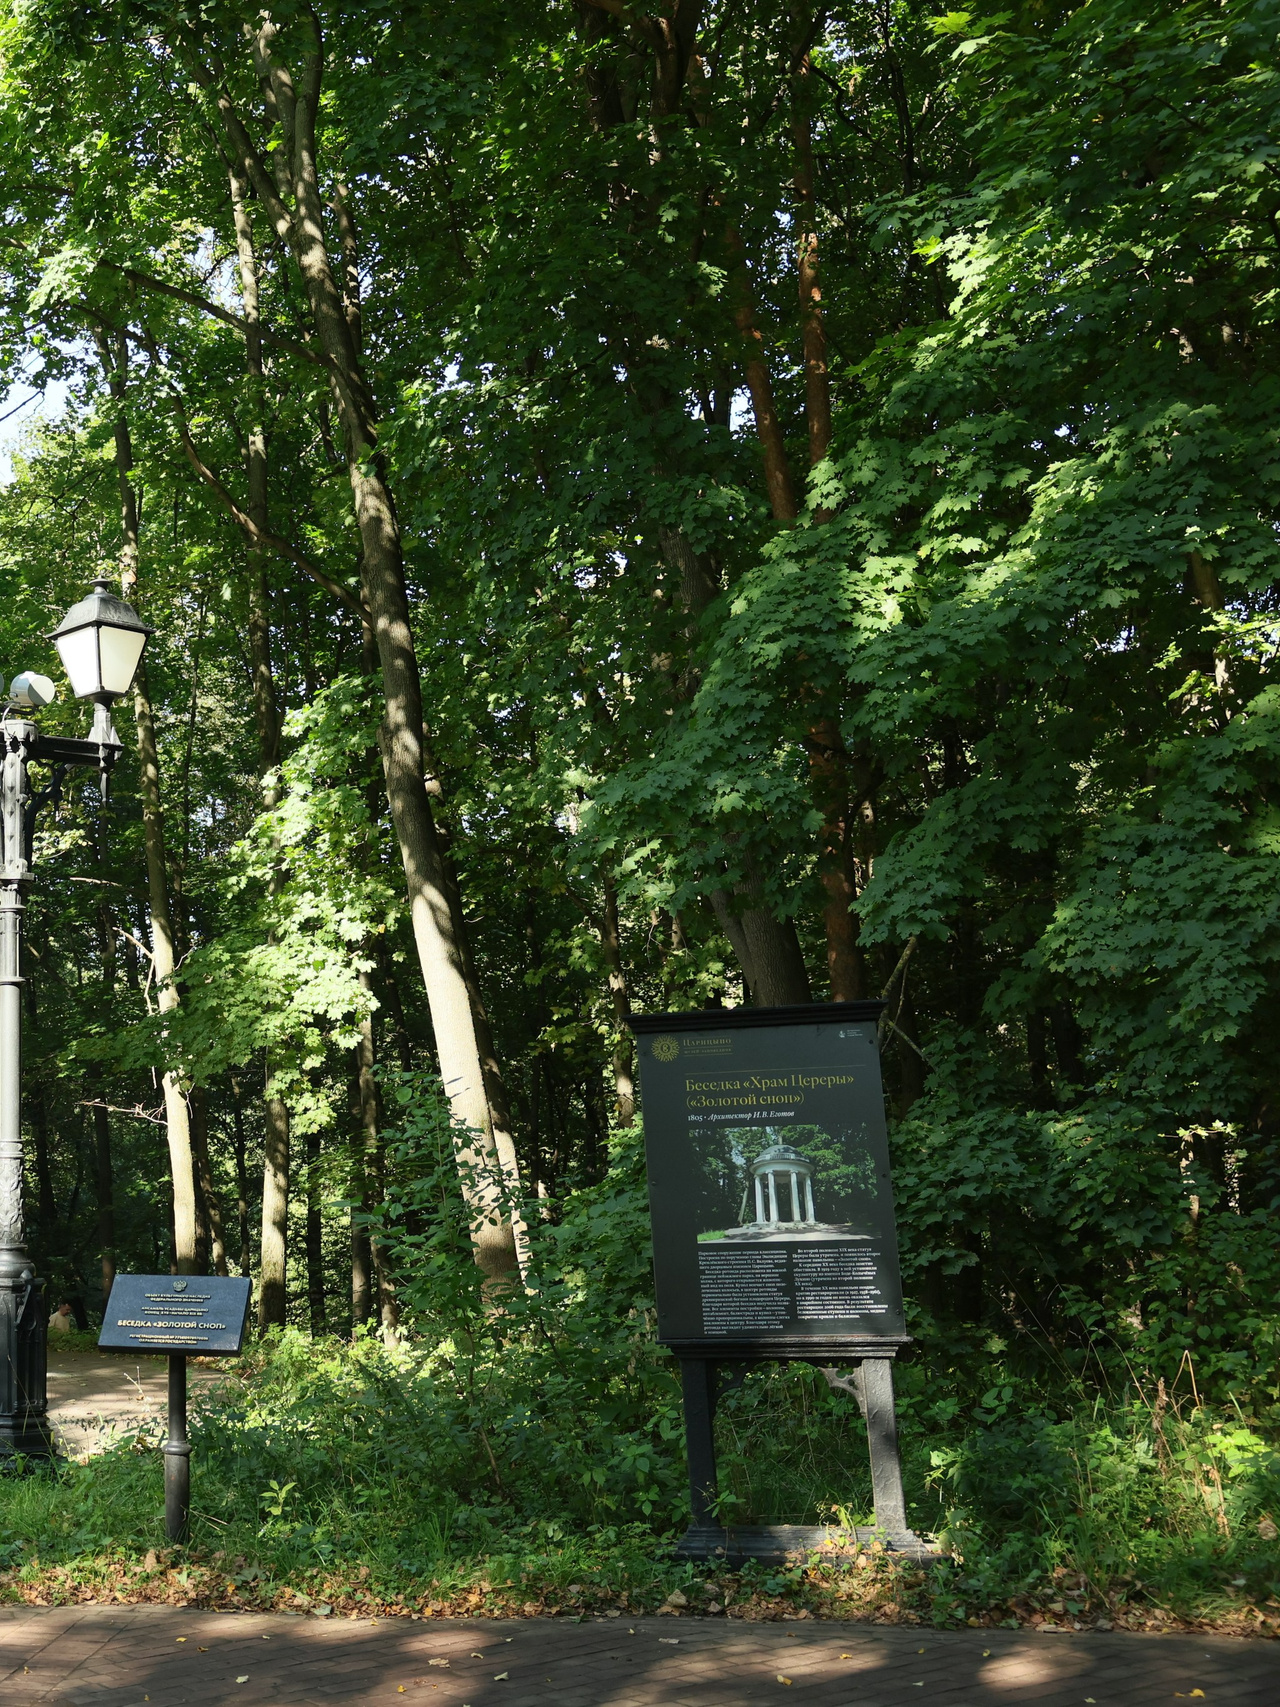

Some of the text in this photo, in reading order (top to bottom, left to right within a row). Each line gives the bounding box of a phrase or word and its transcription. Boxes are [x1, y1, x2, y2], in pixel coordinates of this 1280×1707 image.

[685, 1074, 854, 1092] Беседка «Храм Цереры»
[686, 1091, 804, 1109] («Золотой сноп»)
[687, 1114, 703, 1122] 1805
[708, 1112, 752, 1121] Архитектор
[117, 1319, 226, 1330] БЕСЕДКА «ЗОЛОТОЙ СНОП»
